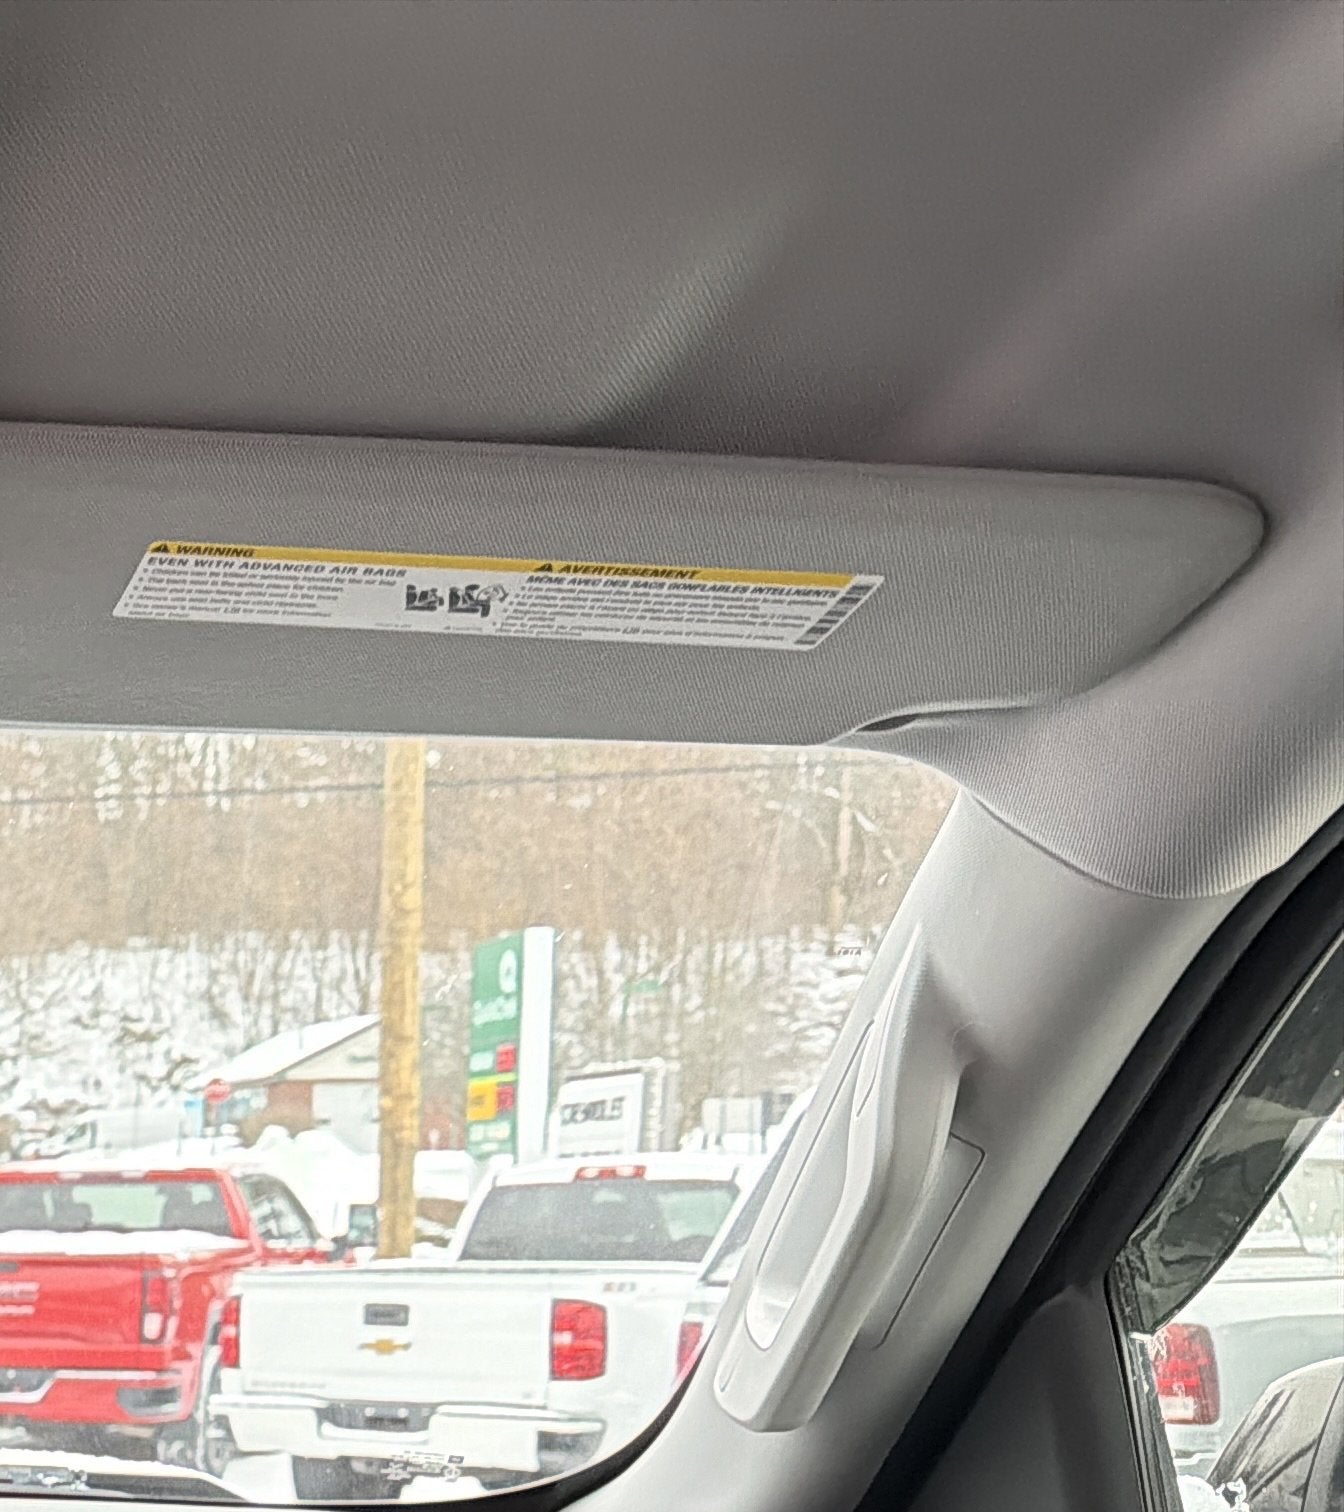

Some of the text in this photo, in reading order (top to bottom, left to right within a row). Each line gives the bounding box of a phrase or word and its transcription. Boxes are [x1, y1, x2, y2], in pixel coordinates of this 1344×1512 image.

[176, 544, 256, 558] WARNING
[147, 556, 189, 567] EVEN
[193, 558, 235, 569] WITH
[238, 560, 326, 574] ADVANCED
[329, 566, 359, 576] AIR
[558, 564, 702, 580] AVERTISSEMENT
[566, 577, 603, 587] AVEC
[603, 578, 629, 588] DES
[630, 579, 666, 590] SACS
